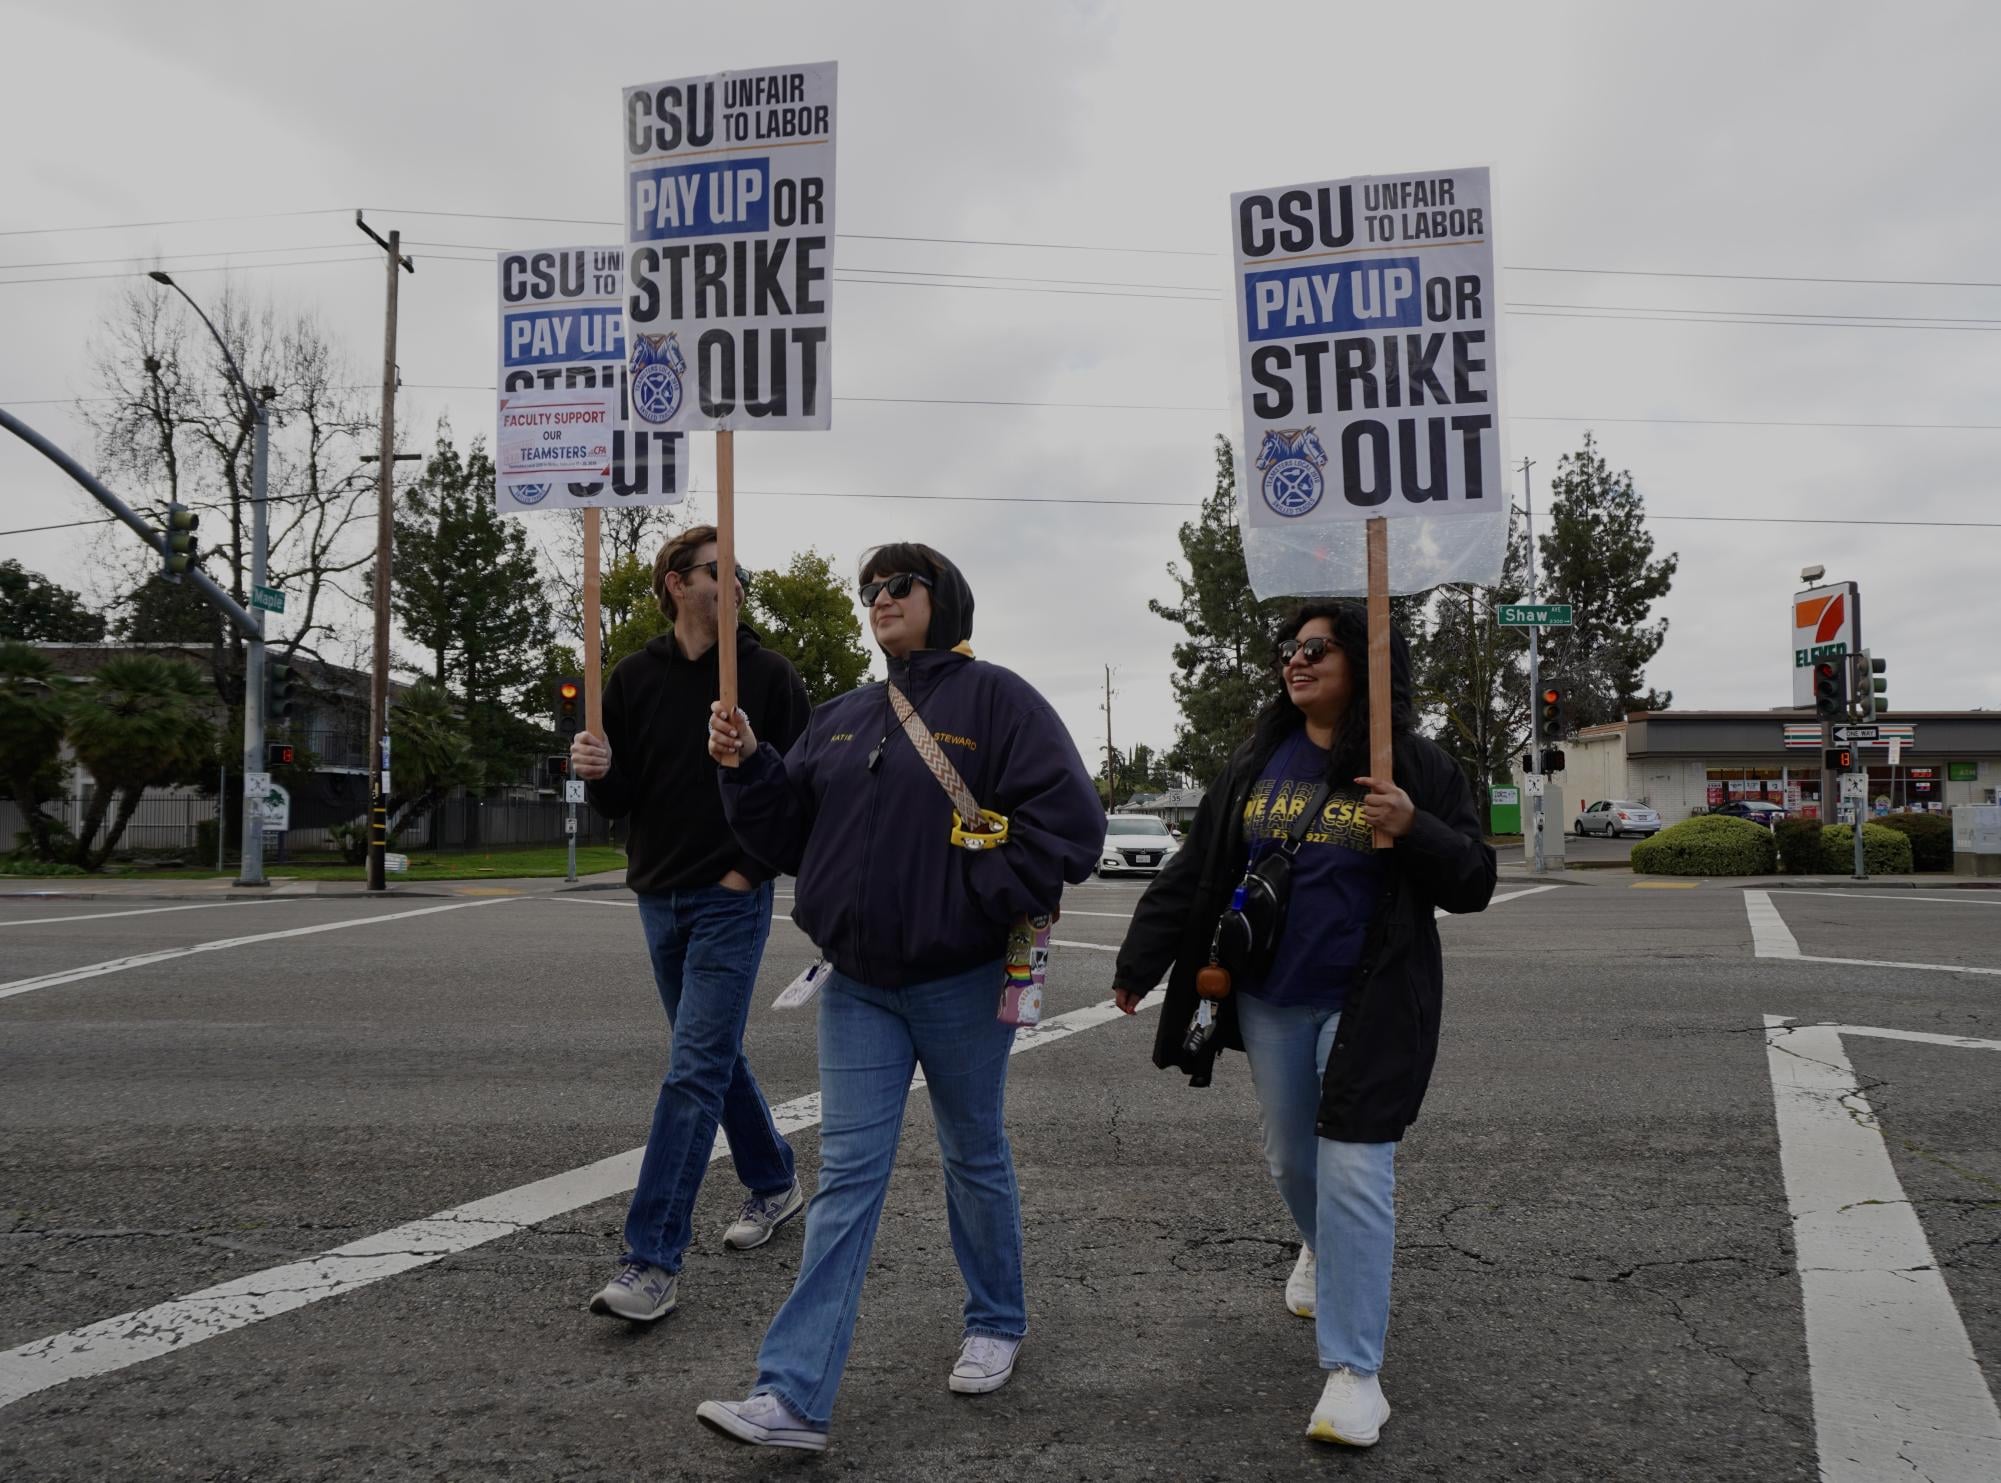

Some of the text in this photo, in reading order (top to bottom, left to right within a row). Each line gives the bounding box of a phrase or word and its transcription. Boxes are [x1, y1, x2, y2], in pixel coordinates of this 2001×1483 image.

[724, 73, 804, 109] UNFAIR
[628, 81, 715, 155] CSU
[724, 105, 829, 142] TO LABOR
[636, 169, 824, 231] PAY UP OR
[1364, 178, 1455, 211] UNFAIR
[1240, 185, 1354, 257] CSU
[1365, 208, 1484, 242] TO LABOR
[503, 251, 585, 302] CSU
[593, 274, 616, 295] TO
[630, 236, 826, 323] STRIKE
[1255, 267, 1482, 330] PAY UP OR
[511, 314, 625, 358] PAY UP
[697, 326, 827, 417] OUT
[1251, 330, 1488, 419] STRIKE
[504, 411, 605, 427] FACULTY SUPPORT
[543, 431, 562, 440] OUR
[521, 446, 587, 460] TEAMSTERS
[1341, 414, 1492, 507] OUT
[254, 589, 283, 609] Maple
[1506, 608, 1547, 621] Shaw
[1795, 593, 1845, 643] 7
[934, 732, 977, 751] STEWARD
[1861, 729, 1874, 737] WAY
[1841, 753, 1850, 766] 13
[1270, 798, 1306, 816] AR
[1273, 829, 1328, 842] ES 927
